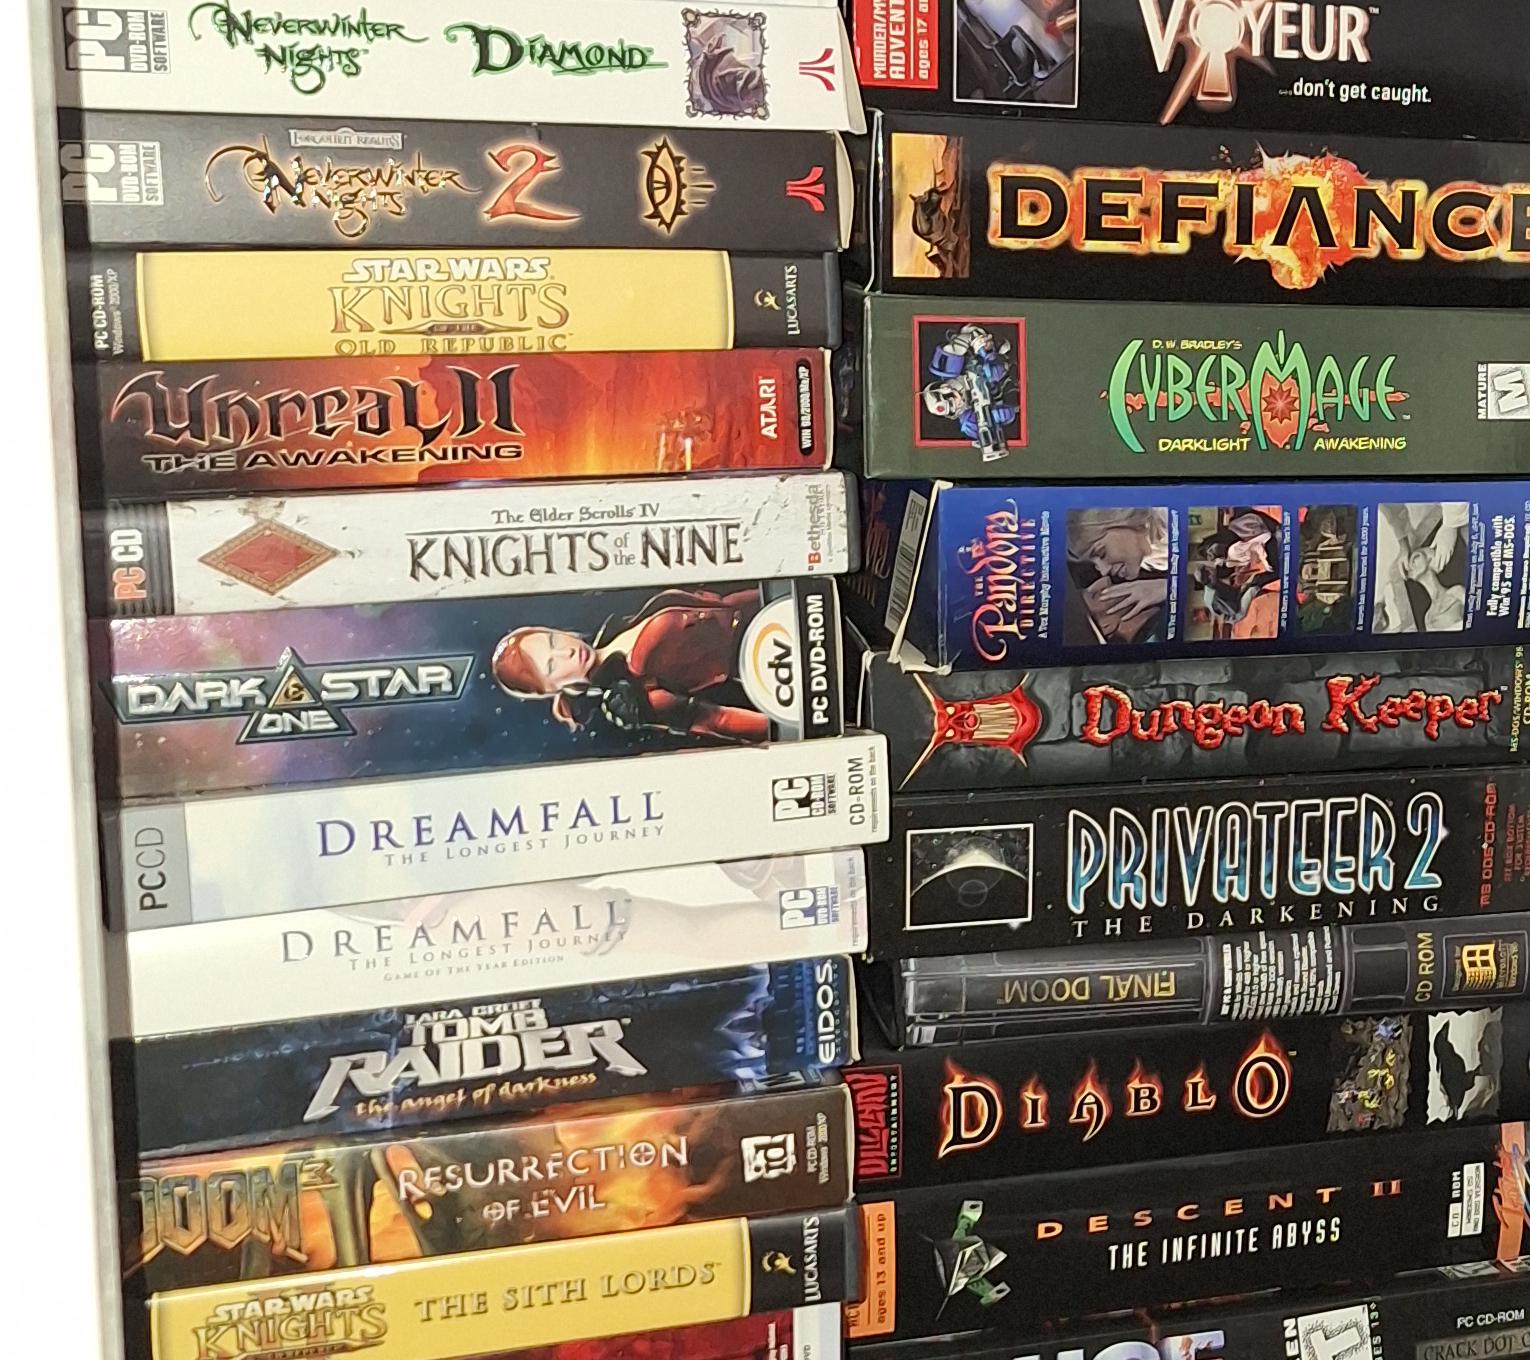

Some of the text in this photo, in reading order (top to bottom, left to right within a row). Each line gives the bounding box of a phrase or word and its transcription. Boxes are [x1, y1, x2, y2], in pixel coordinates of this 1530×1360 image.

[1340, 82, 1367, 104] get
[142, 443, 525, 474] THE AWAKENING
[1157, 436, 1407, 453] DARKLIGHT AWAKENING
[405, 521, 745, 582] KNIGHTS NINE
[125, 662, 457, 714] DARK STAR
[806, 593, 831, 728] PC DVD-ROM
[316, 789, 668, 860] DREAMFALL
[383, 824, 668, 869] THE LONGEST JOURNEY
[1067, 790, 1446, 914] PRIVATEER 2
[1072, 896, 1441, 938] THE DARKENING
[408, 1013, 553, 1045] TOMB
[817, 959, 841, 1066] EIDOS
[300, 1019, 651, 1124] RAIDER
[940, 1030, 1292, 1159] DIABLO
[396, 1135, 690, 1202] RESURRECTION
[1036, 1180, 1402, 1240] DESCENT II
[1108, 1218, 1342, 1272] THE INFINITE ABYSS
[414, 1262, 718, 1323] THE SITH LORDS
